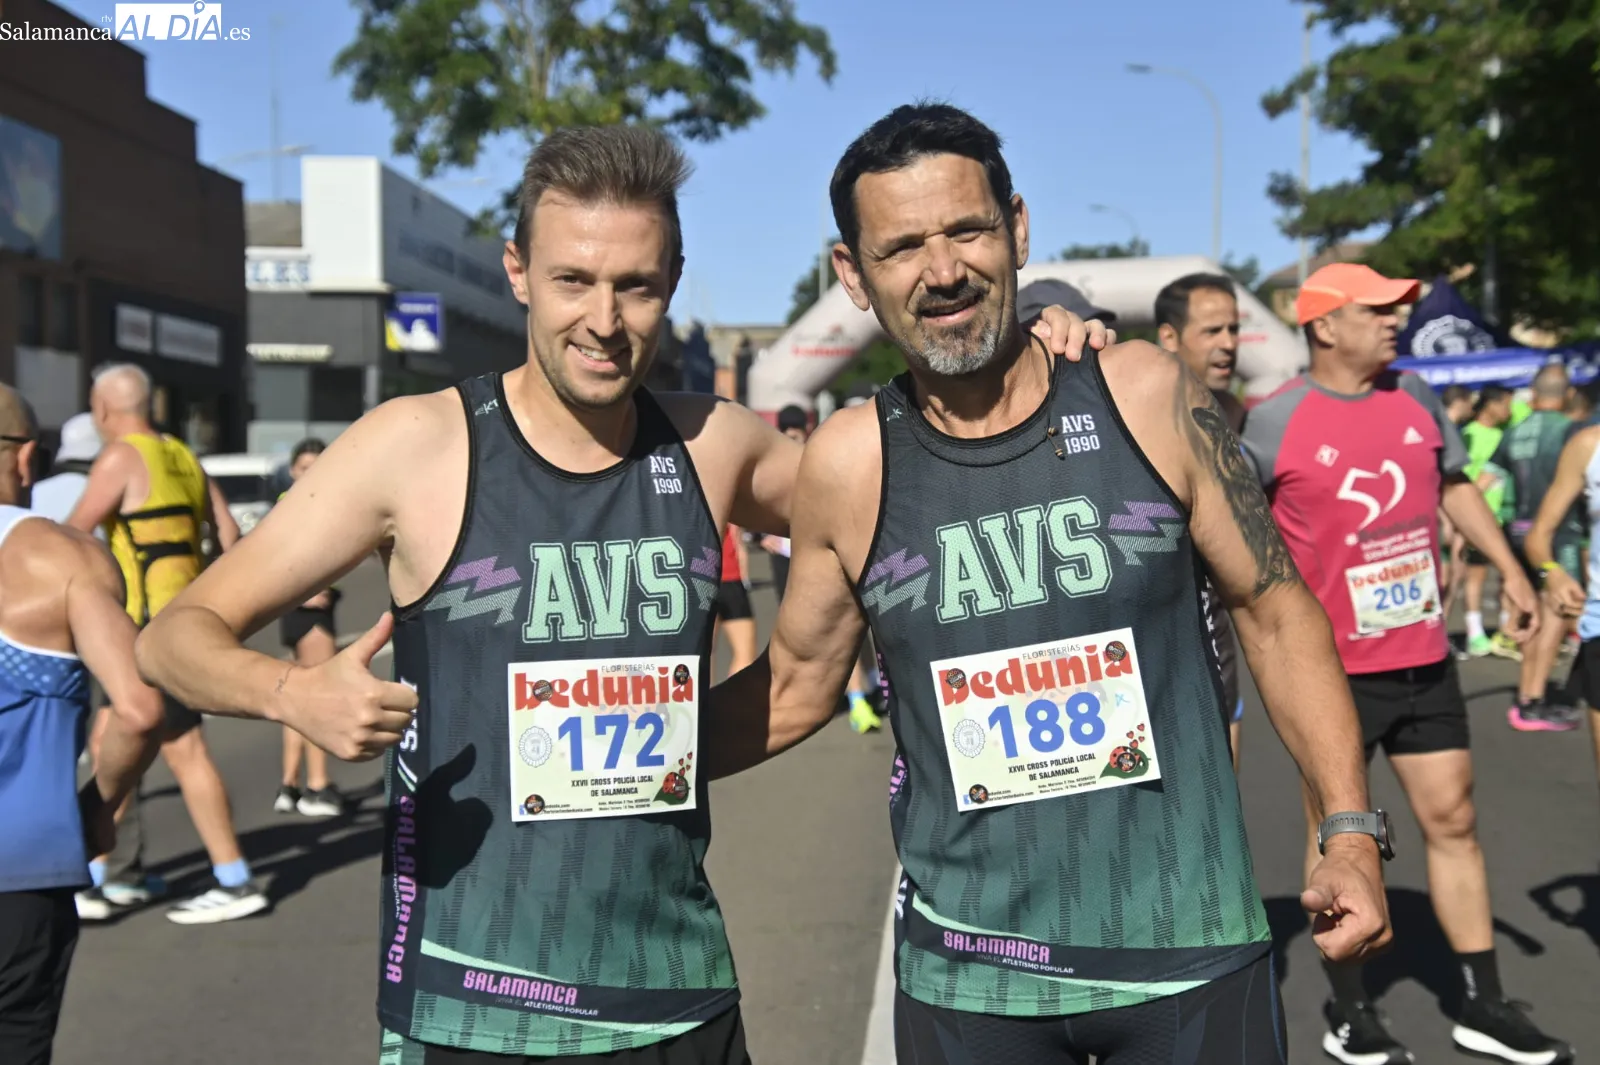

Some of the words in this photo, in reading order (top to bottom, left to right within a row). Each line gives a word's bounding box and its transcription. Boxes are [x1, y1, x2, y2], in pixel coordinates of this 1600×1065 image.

[1061, 414, 1095, 434] AVS
[1064, 434, 1100, 454] 1990
[650, 455, 677, 474] AVS
[653, 478, 682, 494] 1990
[936, 495, 1113, 624] AVS
[522, 536, 688, 643] AVS
[1374, 579, 1422, 610] 206
[938, 644, 1133, 706] bedunia
[514, 666, 694, 711] bedunia
[988, 691, 1106, 759] 188
[558, 712, 665, 772] 172
[1008, 764, 1026, 774] XXVII
[1027, 761, 1049, 771] CROSS
[1050, 756, 1075, 768] POLICÍA
[1076, 753, 1097, 764] LOCAL
[1029, 773, 1038, 781] DE
[1039, 767, 1080, 780] SALAMANCA
[571, 779, 588, 788] XXVII
[590, 778, 611, 786] CROSS
[637, 775, 654, 783] LOCAL
[590, 789, 599, 797] DE
[601, 787, 639, 797] SALAMANCA
[943, 930, 1050, 964] SALAMANCA
[1002, 957, 1039, 970] ATLETISMO
[1040, 965, 1074, 974] POPULAR
[463, 969, 578, 1006] SALAMANCA
[523, 1001, 564, 1012] ATLETISMO
[565, 1007, 599, 1016] POPULAR
